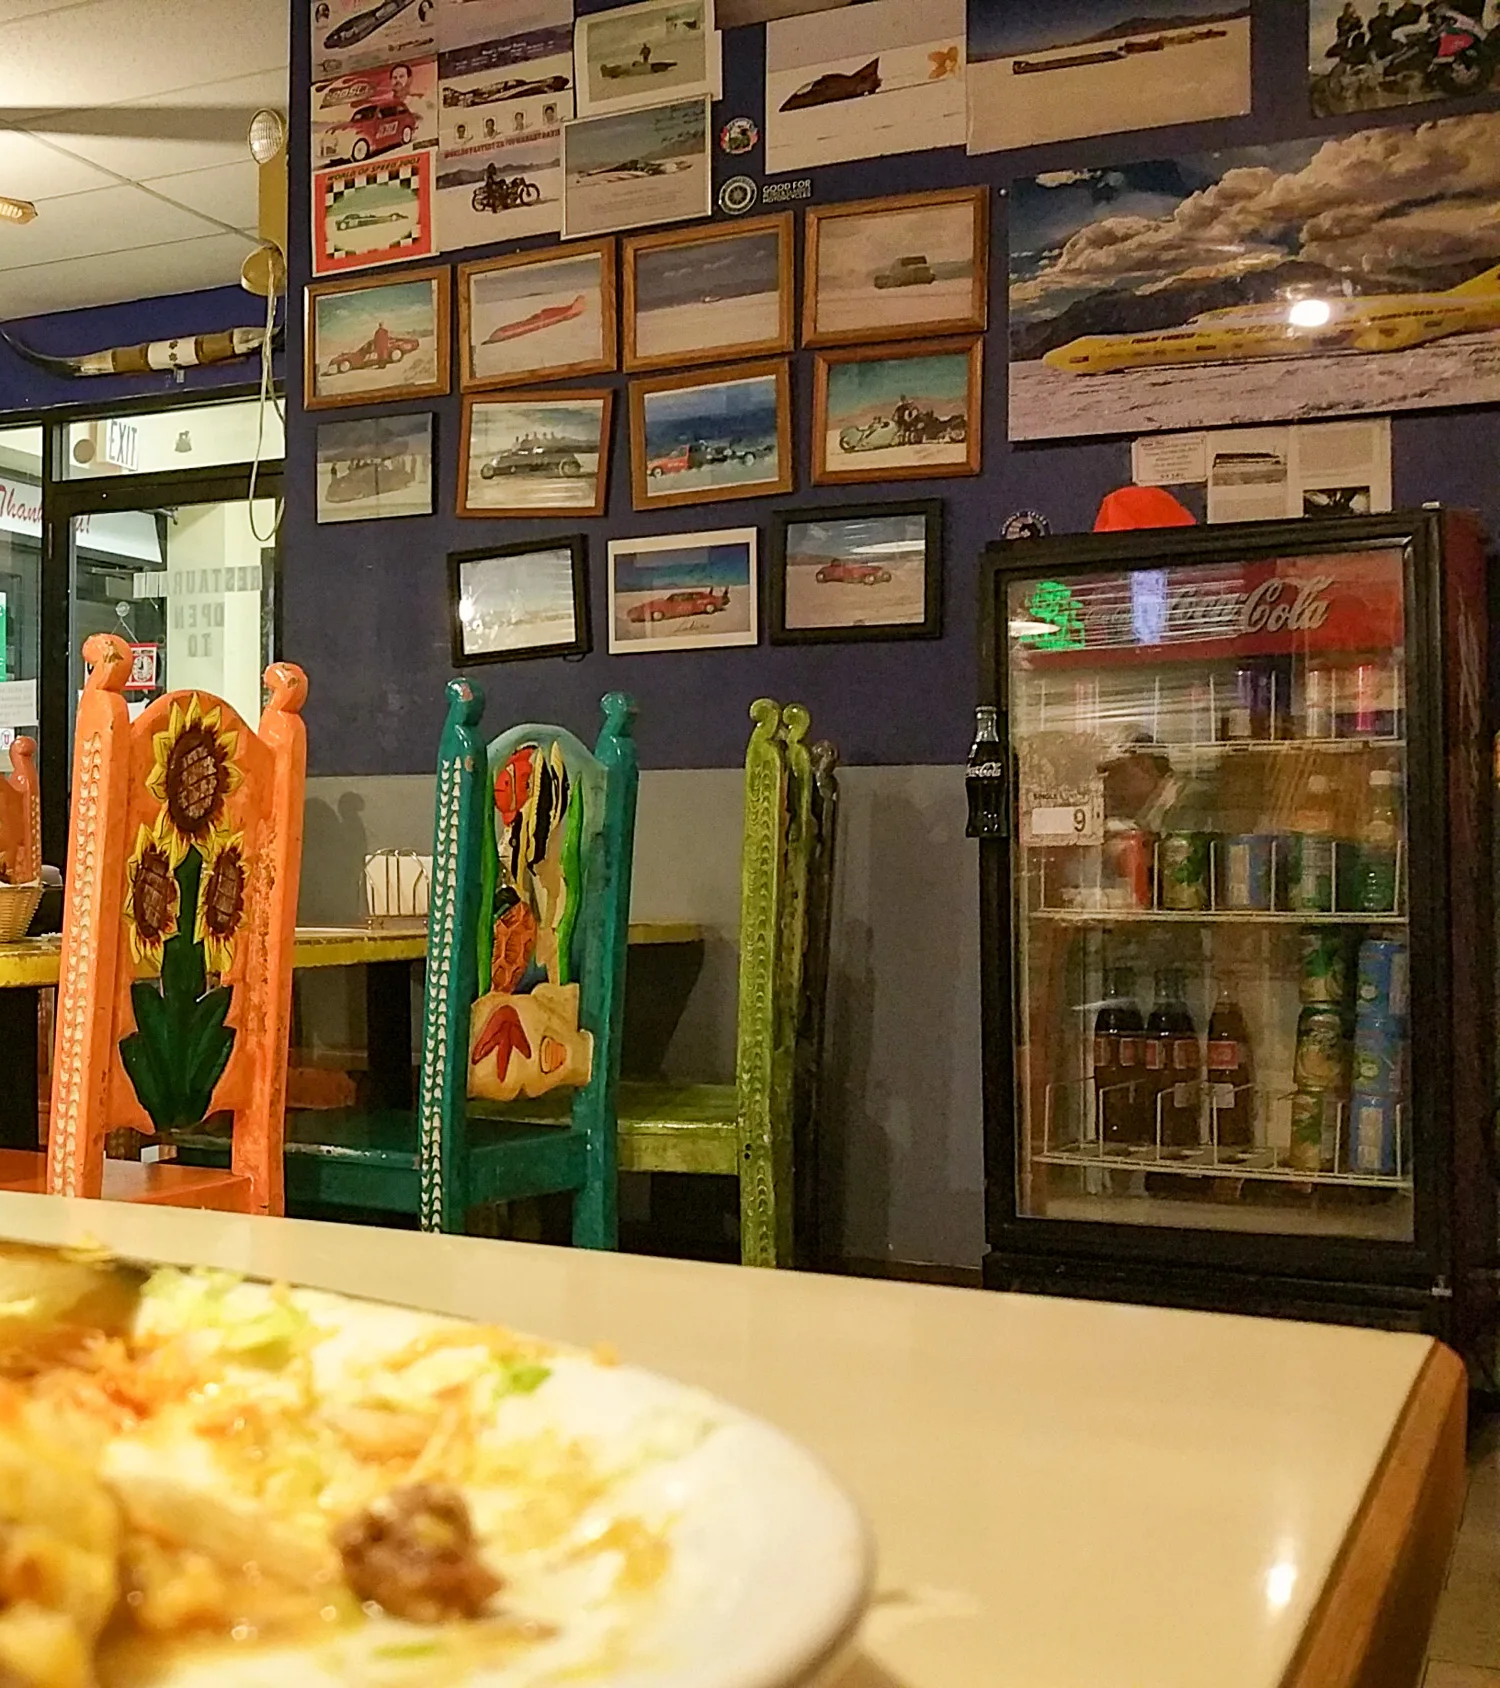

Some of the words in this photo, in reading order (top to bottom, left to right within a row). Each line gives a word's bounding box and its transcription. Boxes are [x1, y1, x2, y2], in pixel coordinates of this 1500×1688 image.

[763, 182, 791, 193] GOOD
[792, 179, 811, 189] FOR
[109, 420, 138, 467] EXIT
